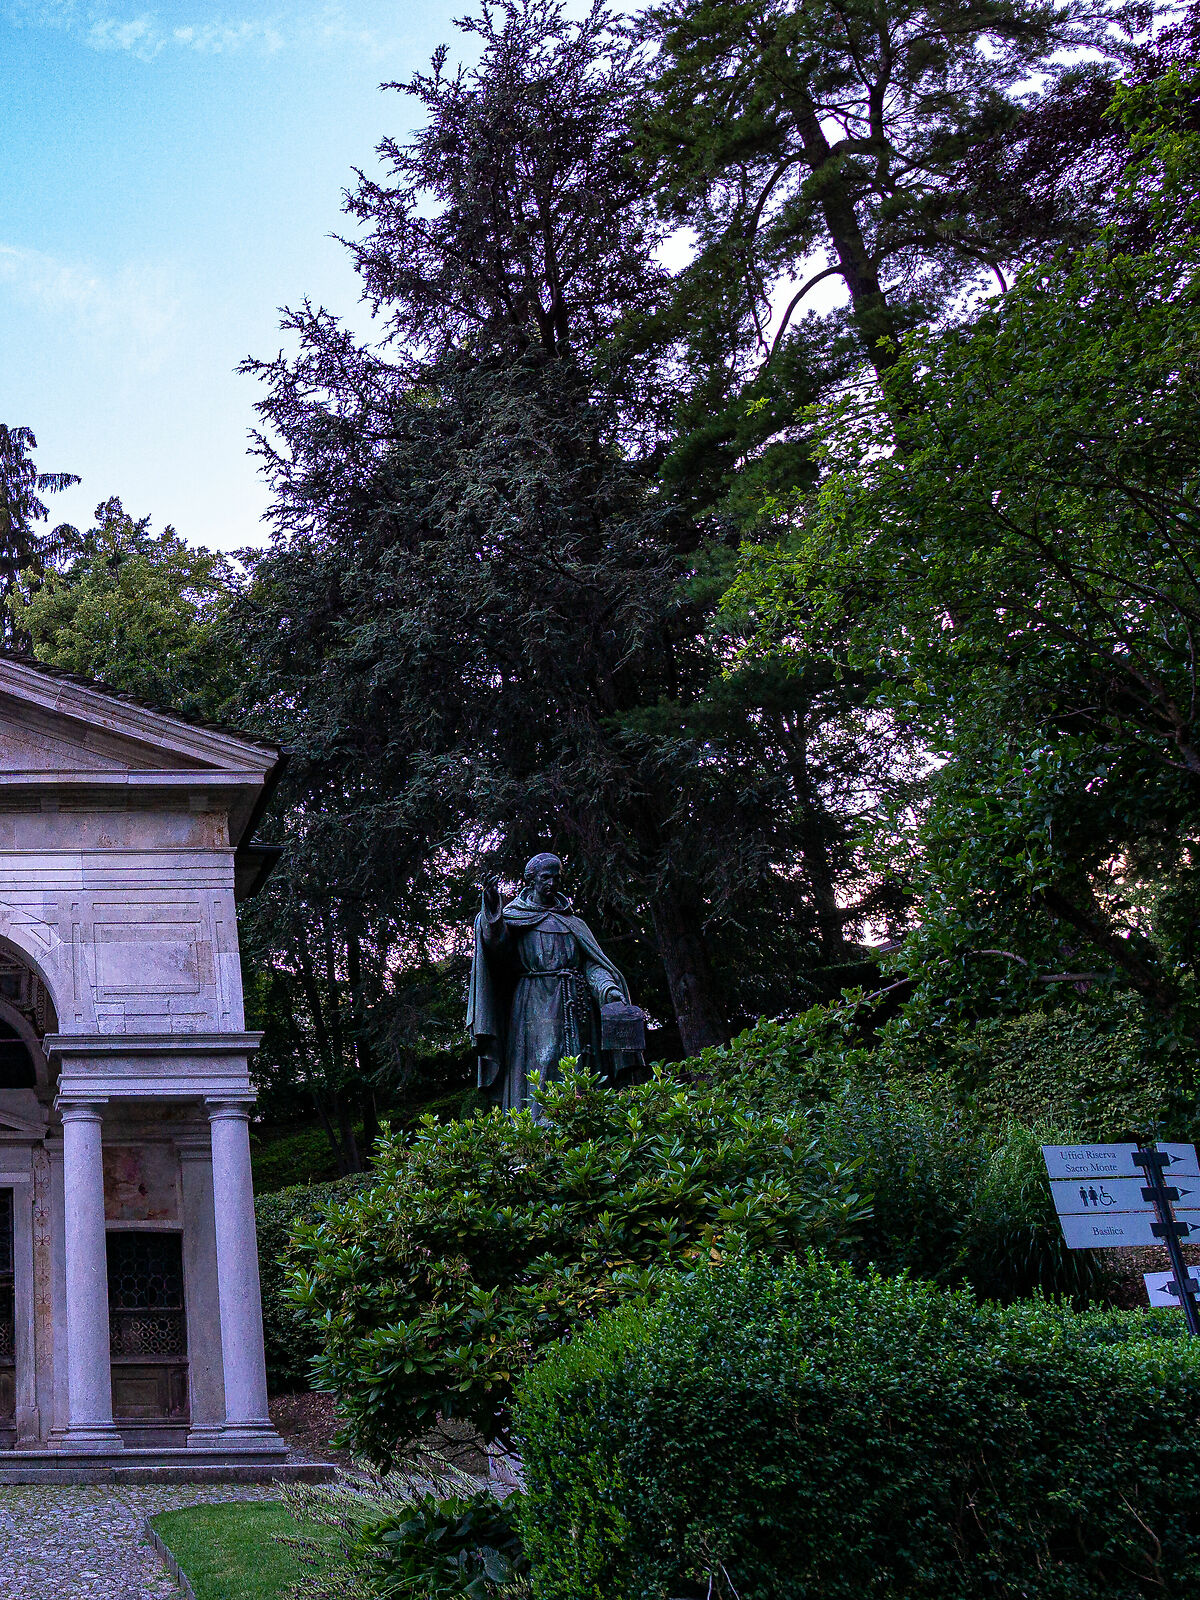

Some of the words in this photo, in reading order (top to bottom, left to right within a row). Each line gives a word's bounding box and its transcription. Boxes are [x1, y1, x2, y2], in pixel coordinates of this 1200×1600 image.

[1060, 1151, 1085, 1160] Uffici
[1086, 1150, 1117, 1159] Riserva
[1065, 1163, 1089, 1173] Sacro
[1091, 1162, 1118, 1171] Monte
[1092, 1226, 1124, 1236] Basilica
